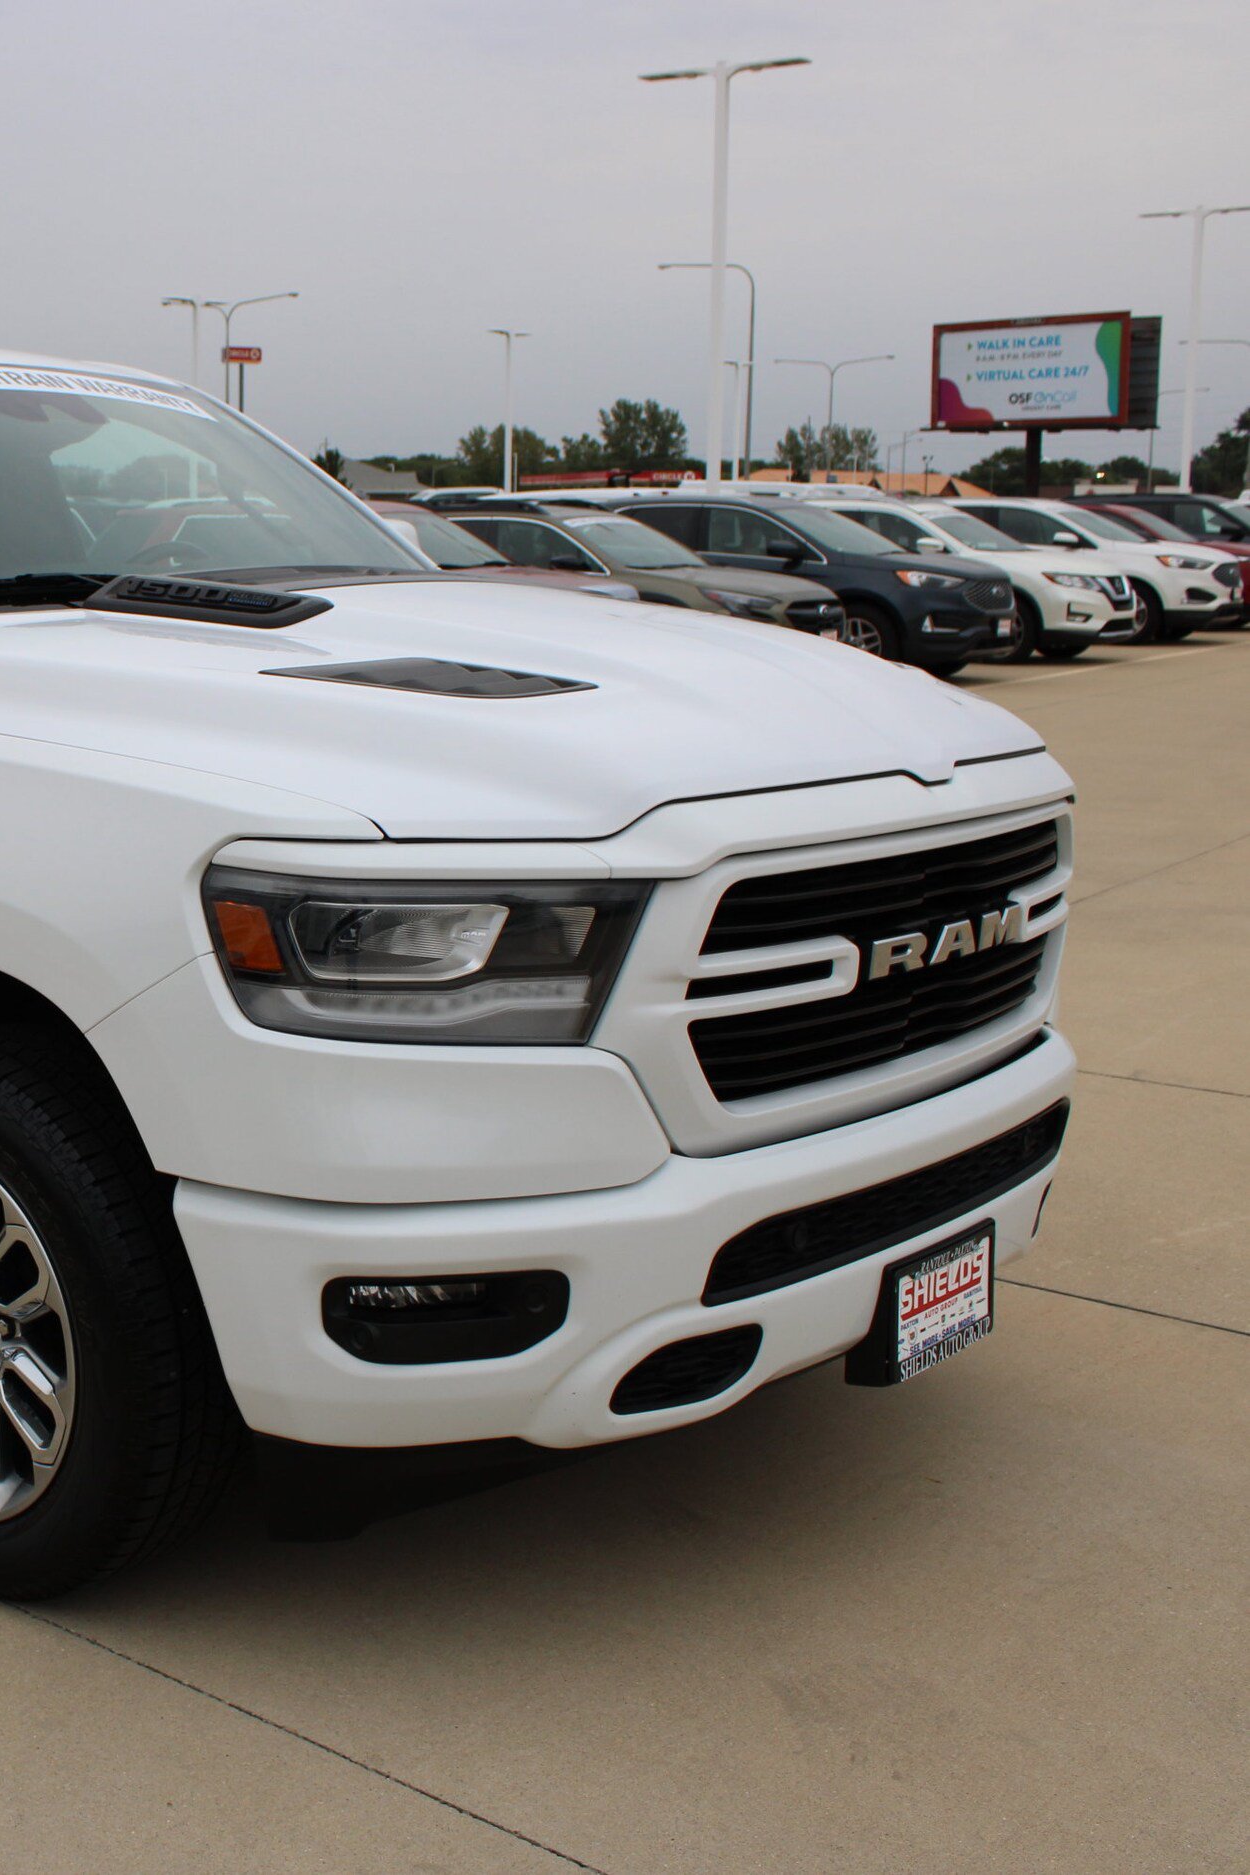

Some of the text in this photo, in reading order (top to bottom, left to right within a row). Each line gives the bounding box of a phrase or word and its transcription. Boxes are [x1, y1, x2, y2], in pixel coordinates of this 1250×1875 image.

[977, 335, 1061, 350] WALK IN CARE
[976, 366, 1089, 382] VIRTUAL CARE 24/7
[1009, 392, 1033, 405] OSF
[125, 579, 227, 602] 1500
[869, 902, 1022, 981] RAM
[901, 1253, 984, 1314] SHIELDS
[924, 1297, 958, 1319] AUTO GROUP
[901, 1316, 990, 1382] SHIELDS AUTO GROUP
[910, 1342, 920, 1354] SEE
[942, 1325, 956, 1338] SAVE
